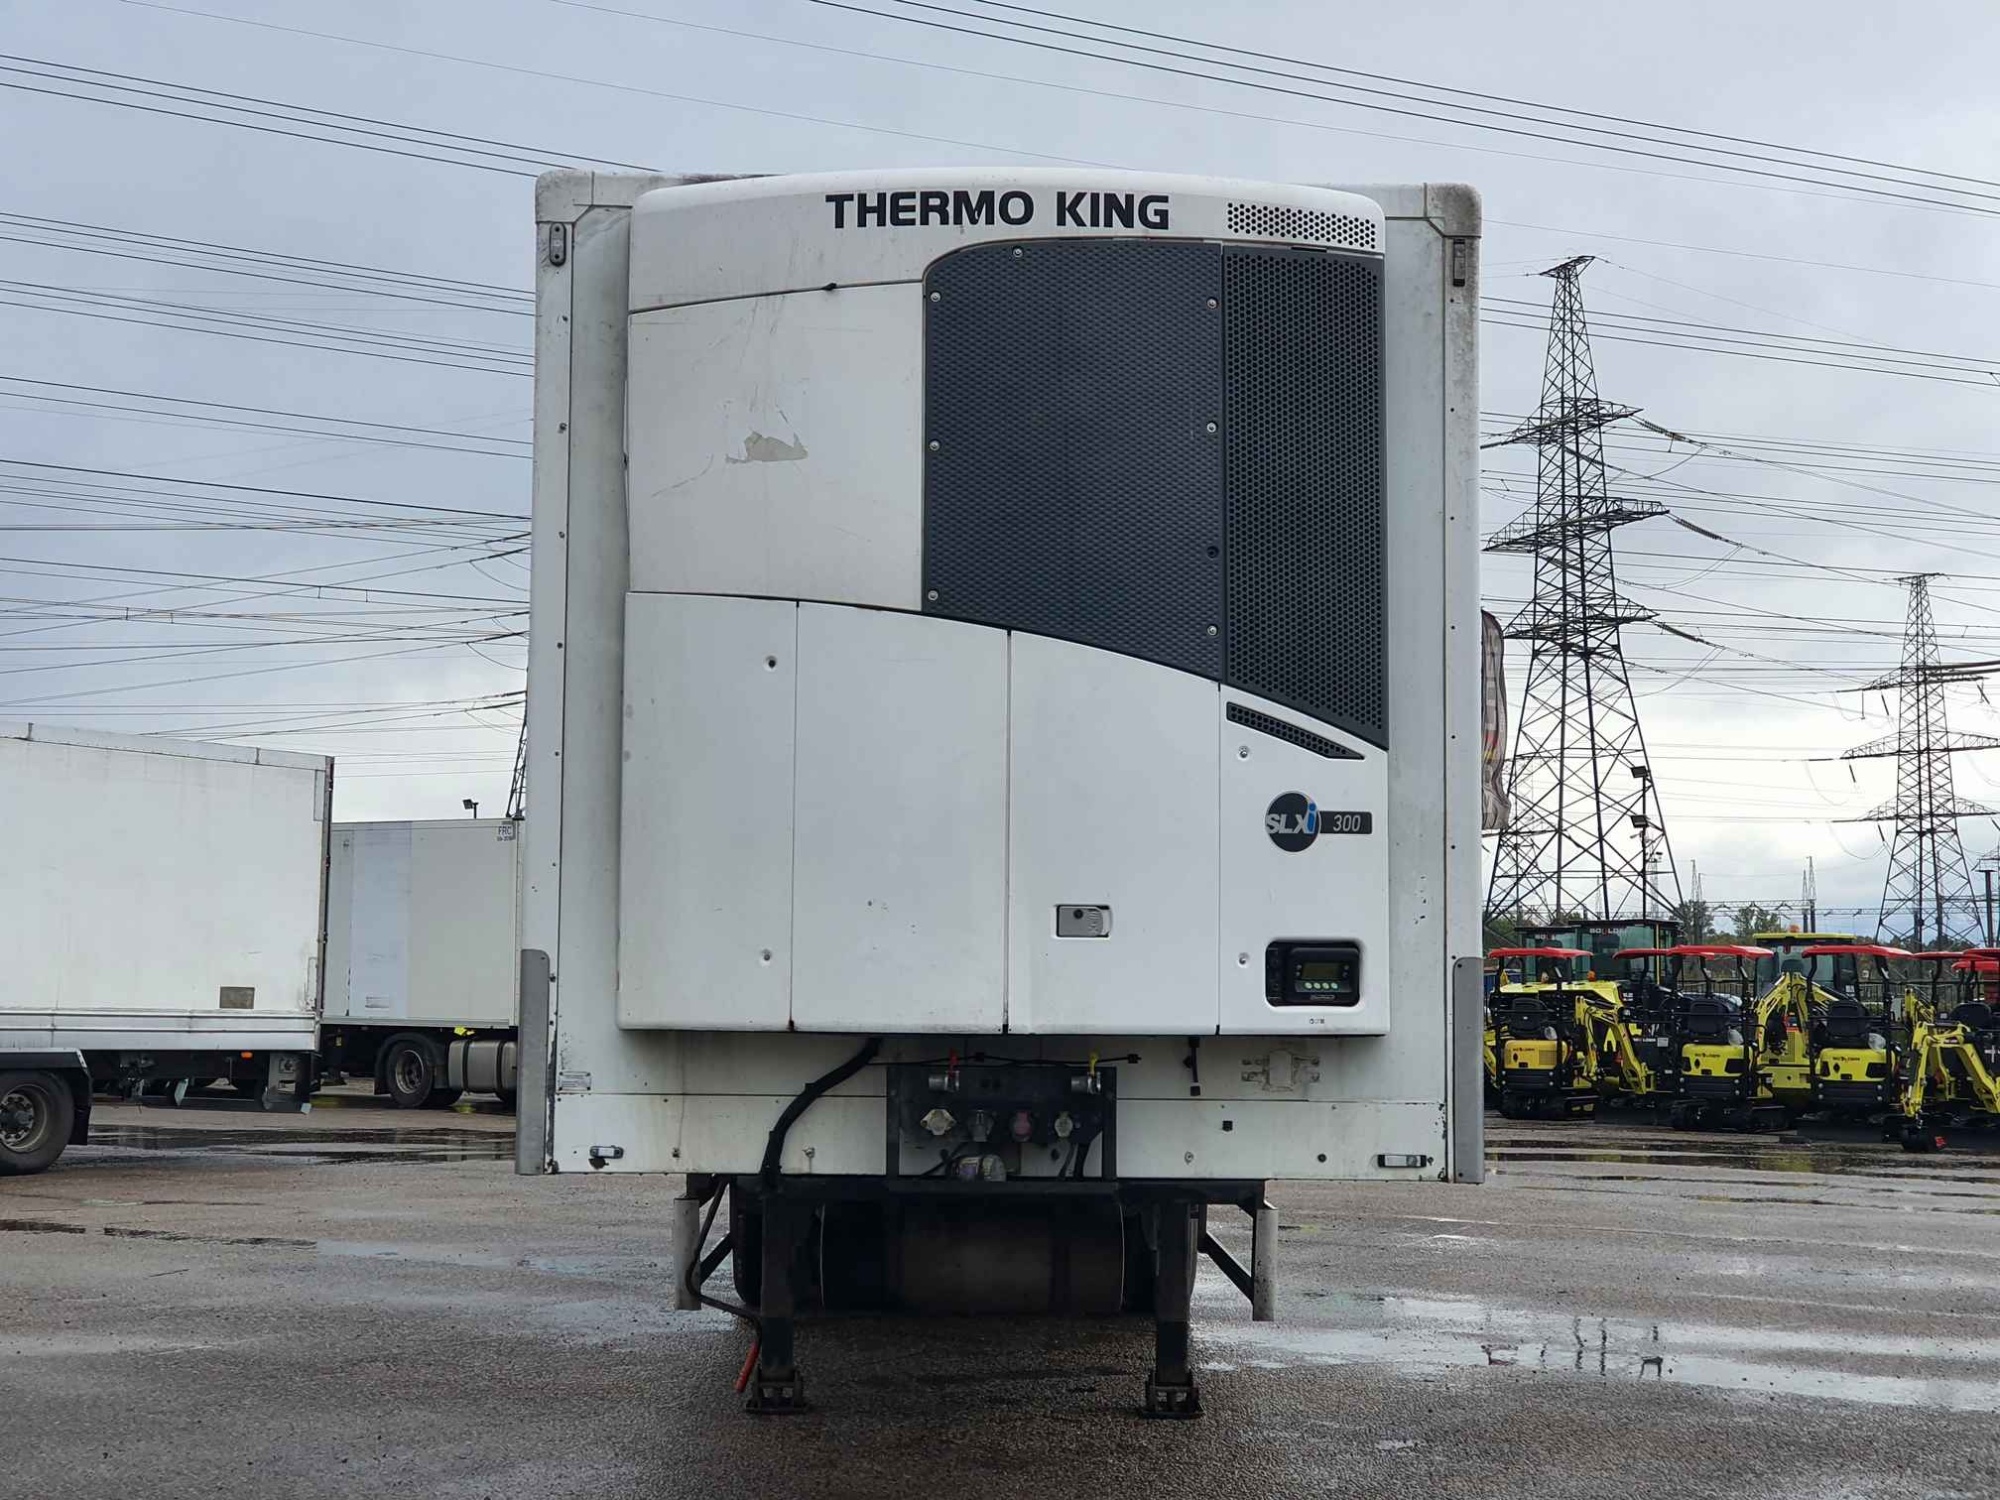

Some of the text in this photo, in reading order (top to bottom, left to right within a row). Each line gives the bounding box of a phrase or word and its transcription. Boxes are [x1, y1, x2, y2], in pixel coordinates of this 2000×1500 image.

[825, 190, 1169, 230] THERMO KING
[498, 825, 512, 835] FRC
[1333, 814, 1361, 832] 300
